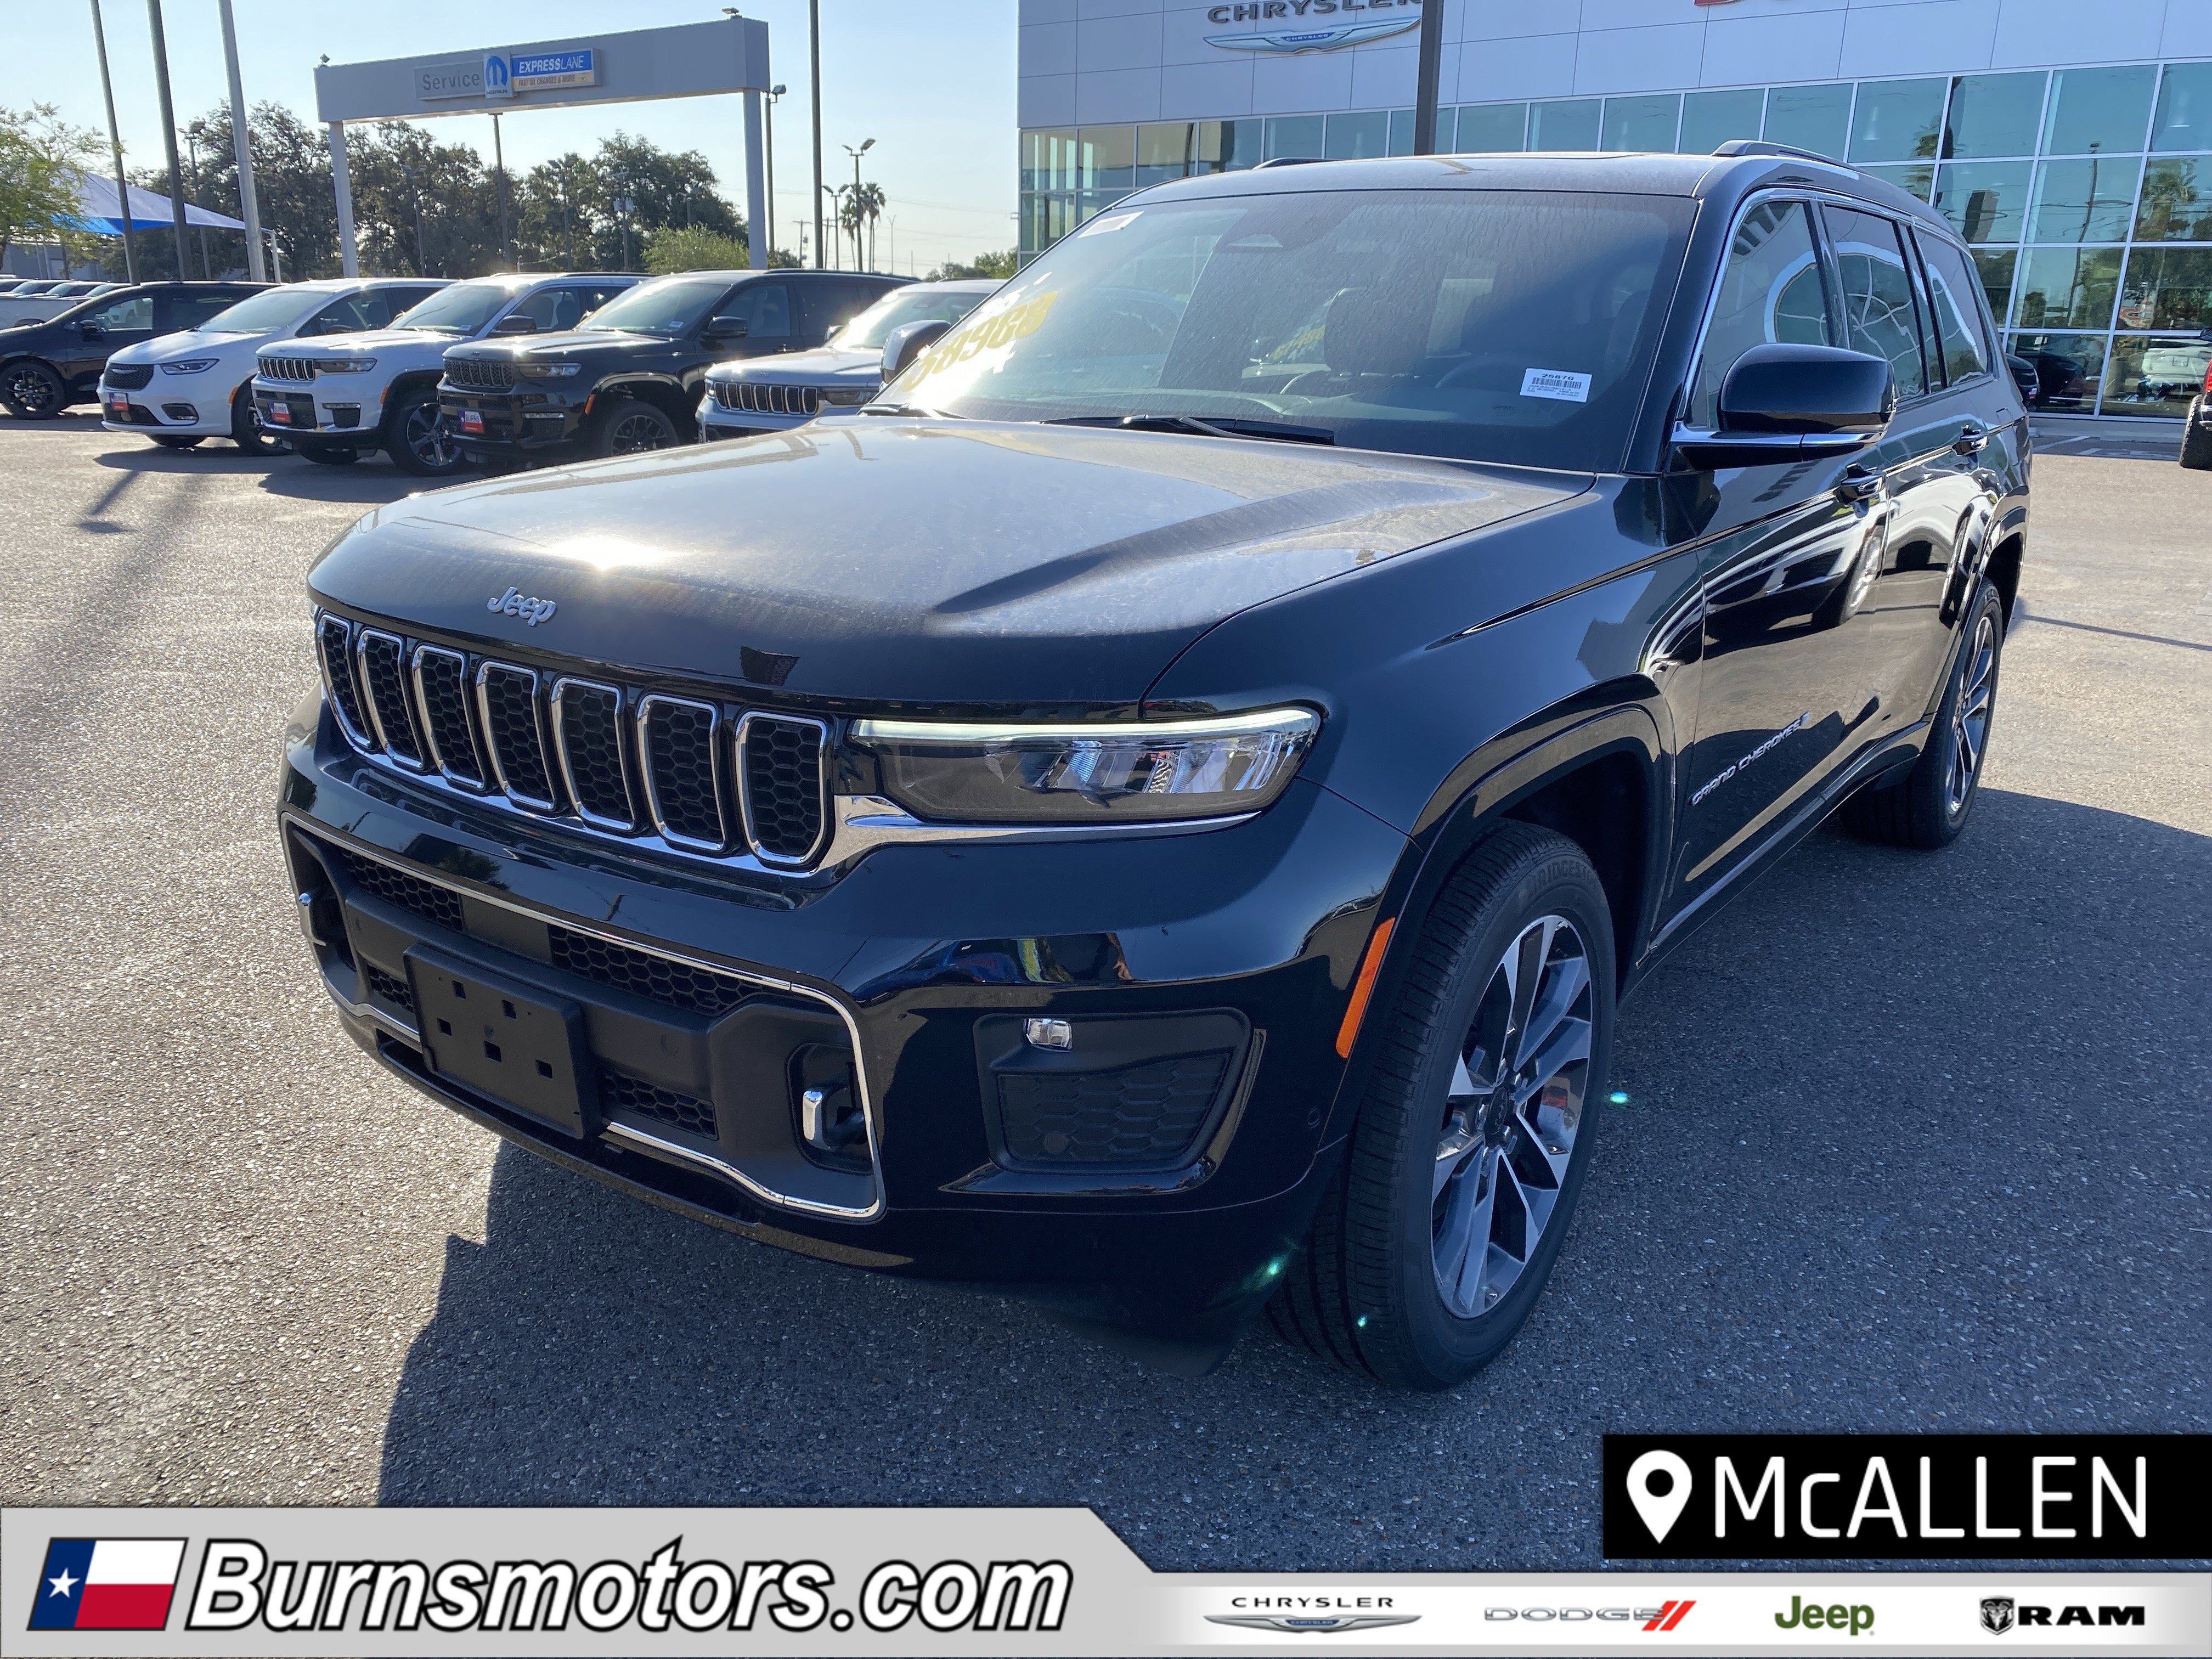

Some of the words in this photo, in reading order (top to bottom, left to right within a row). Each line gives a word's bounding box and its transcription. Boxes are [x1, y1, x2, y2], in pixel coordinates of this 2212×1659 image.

[1207, 0, 1422, 23] CHRYSL
[422, 71, 480, 91] Service
[518, 78, 528, 87] FAST
[562, 75, 575, 83] MORE
[465, 413, 479, 422] BURNS
[487, 586, 557, 627] Jeep
[1691, 765, 1736, 806] GRAND
[1737, 719, 1802, 771] CHEROKEE
